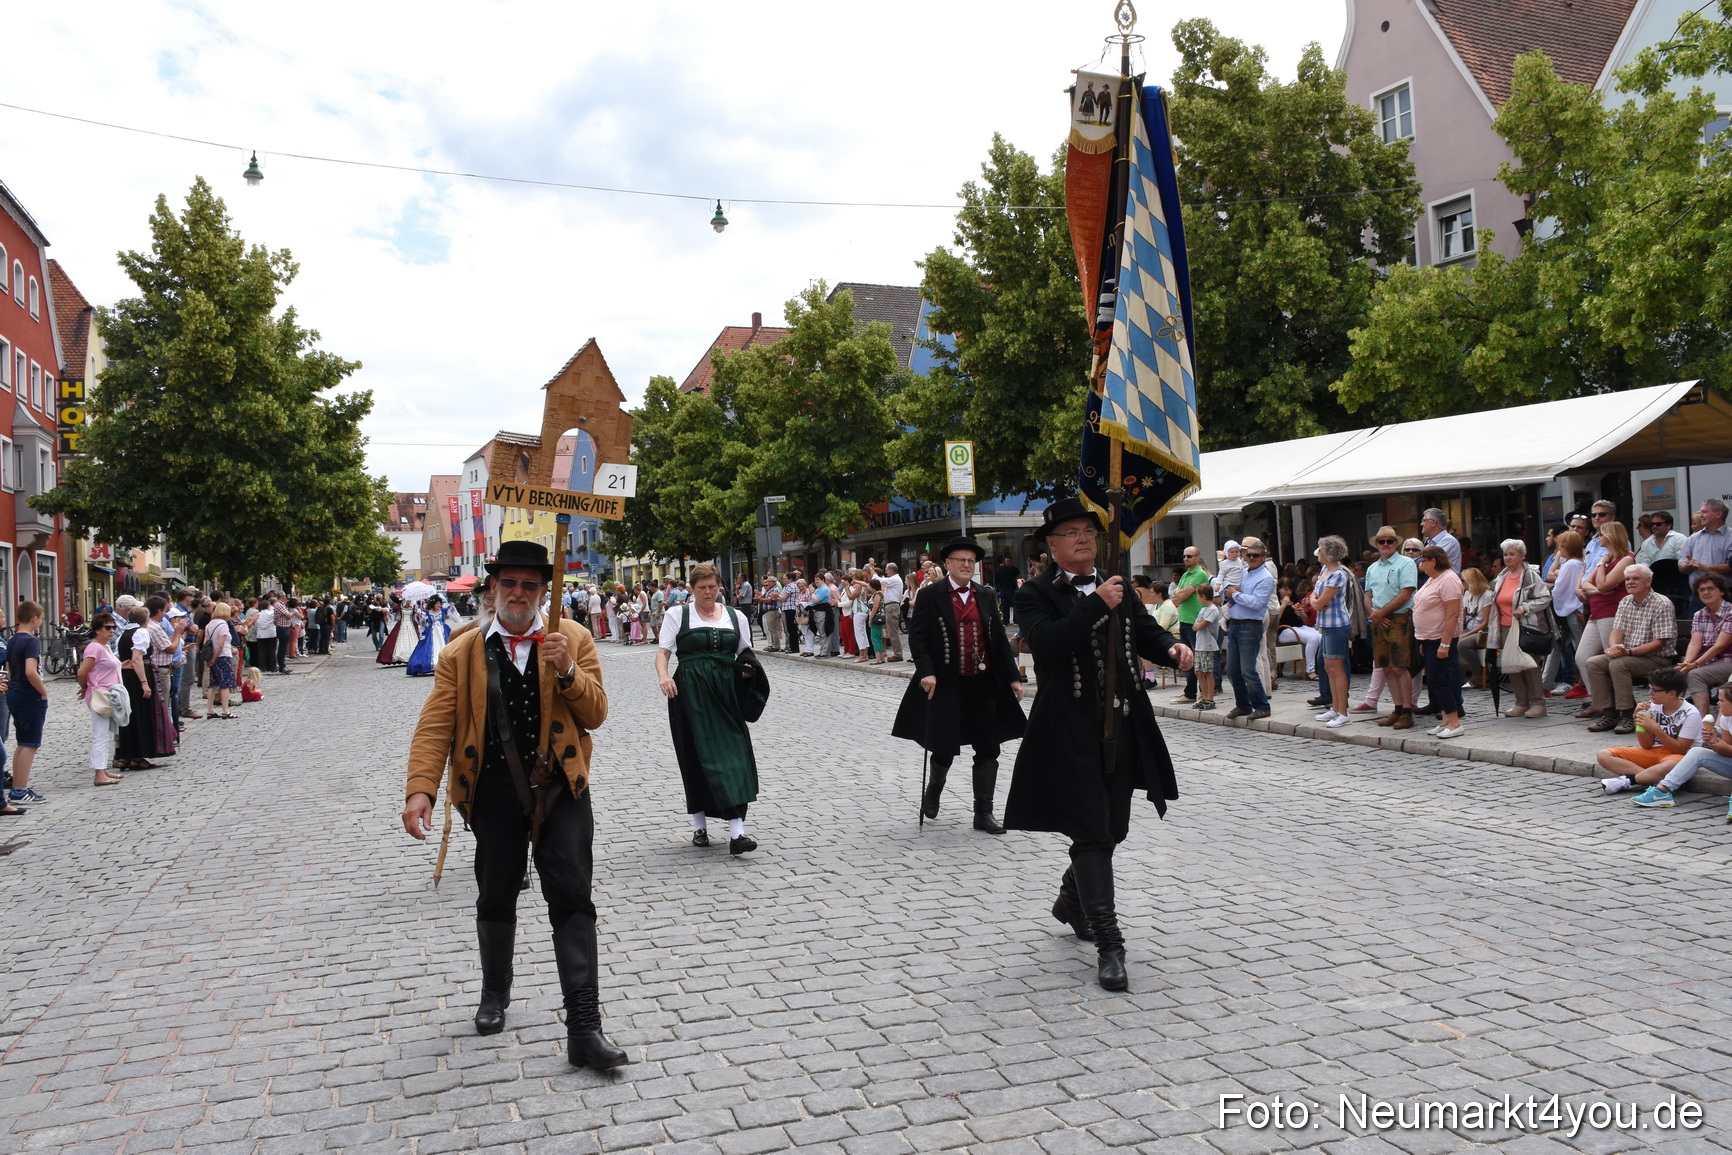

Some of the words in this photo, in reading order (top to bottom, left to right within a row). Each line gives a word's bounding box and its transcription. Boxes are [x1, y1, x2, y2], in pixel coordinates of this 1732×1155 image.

[61, 381, 86, 466] HOT
[955, 450, 965, 461] H
[608, 474, 626, 490] 21
[493, 484, 525, 503] VTV
